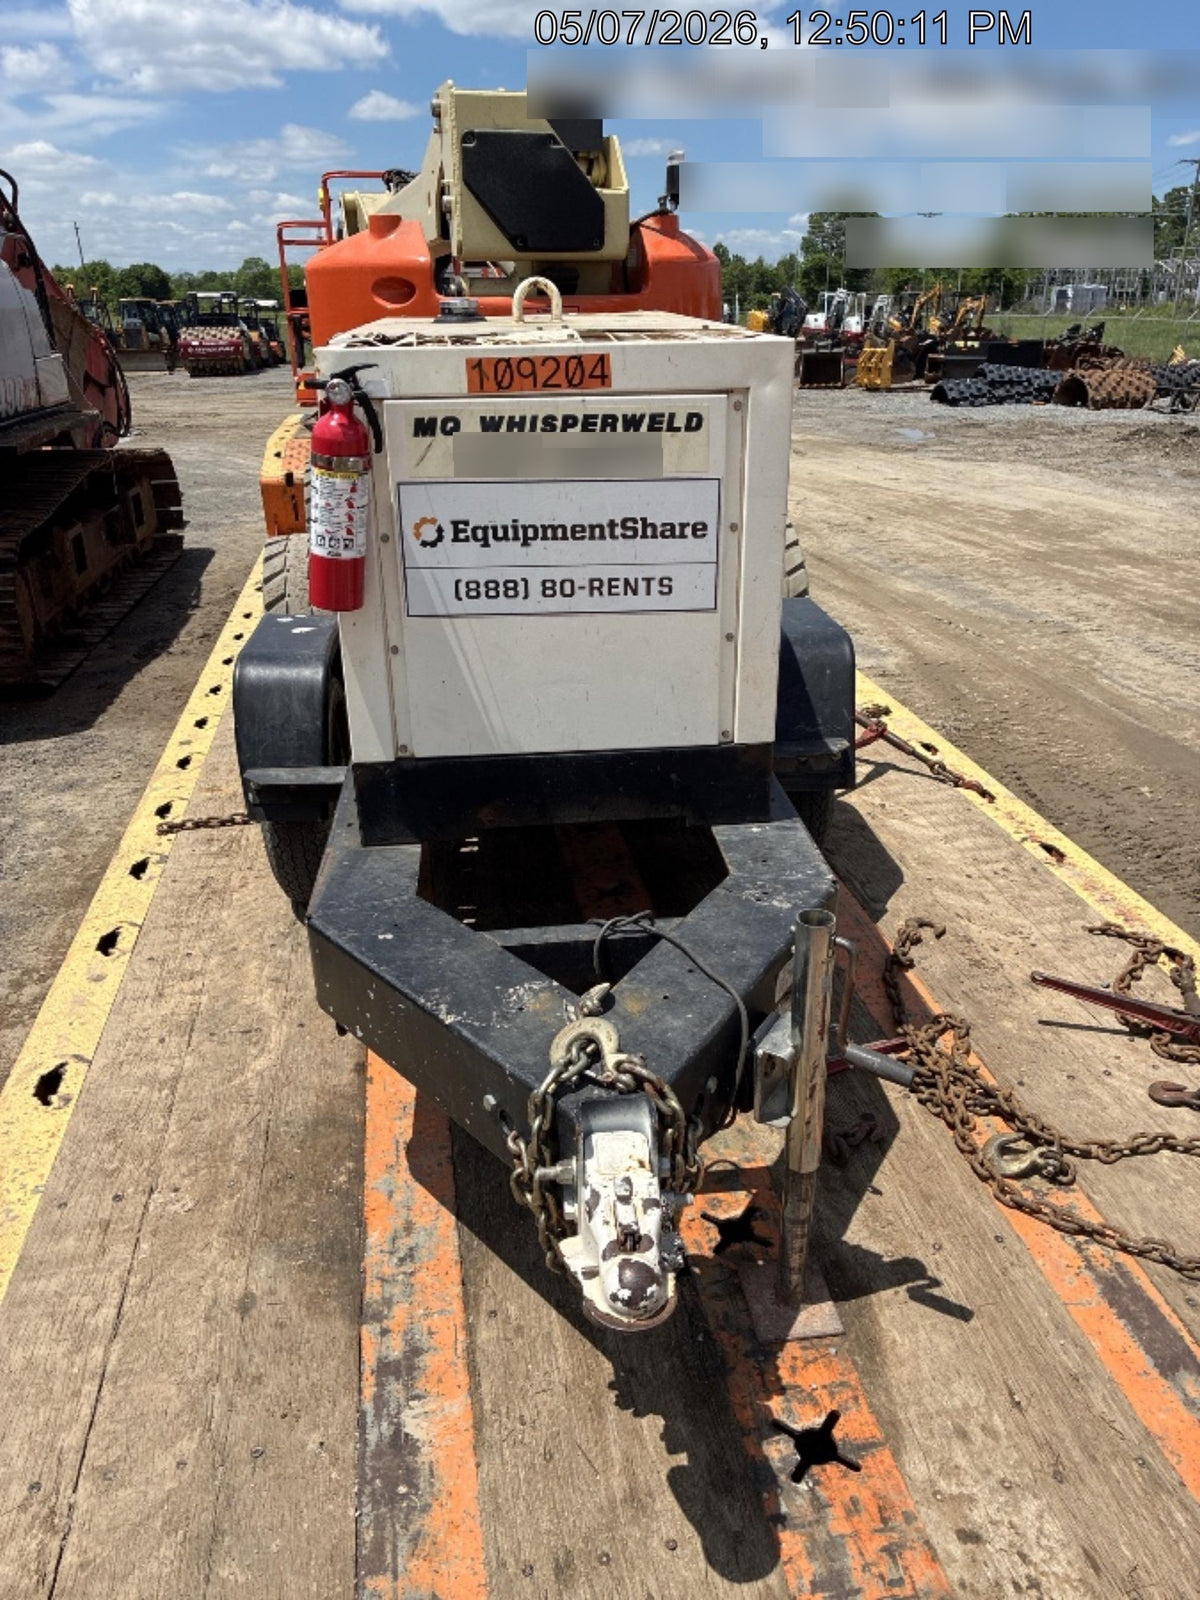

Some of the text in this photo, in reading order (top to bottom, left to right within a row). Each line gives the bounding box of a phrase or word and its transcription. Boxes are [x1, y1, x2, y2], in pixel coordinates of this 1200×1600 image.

[471, 353, 609, 391] 109204
[479, 412, 704, 433] WHISPERWELD
[450, 516, 708, 548] EquipmentShare
[454, 576, 673, 601] (888) 80-RENTS
